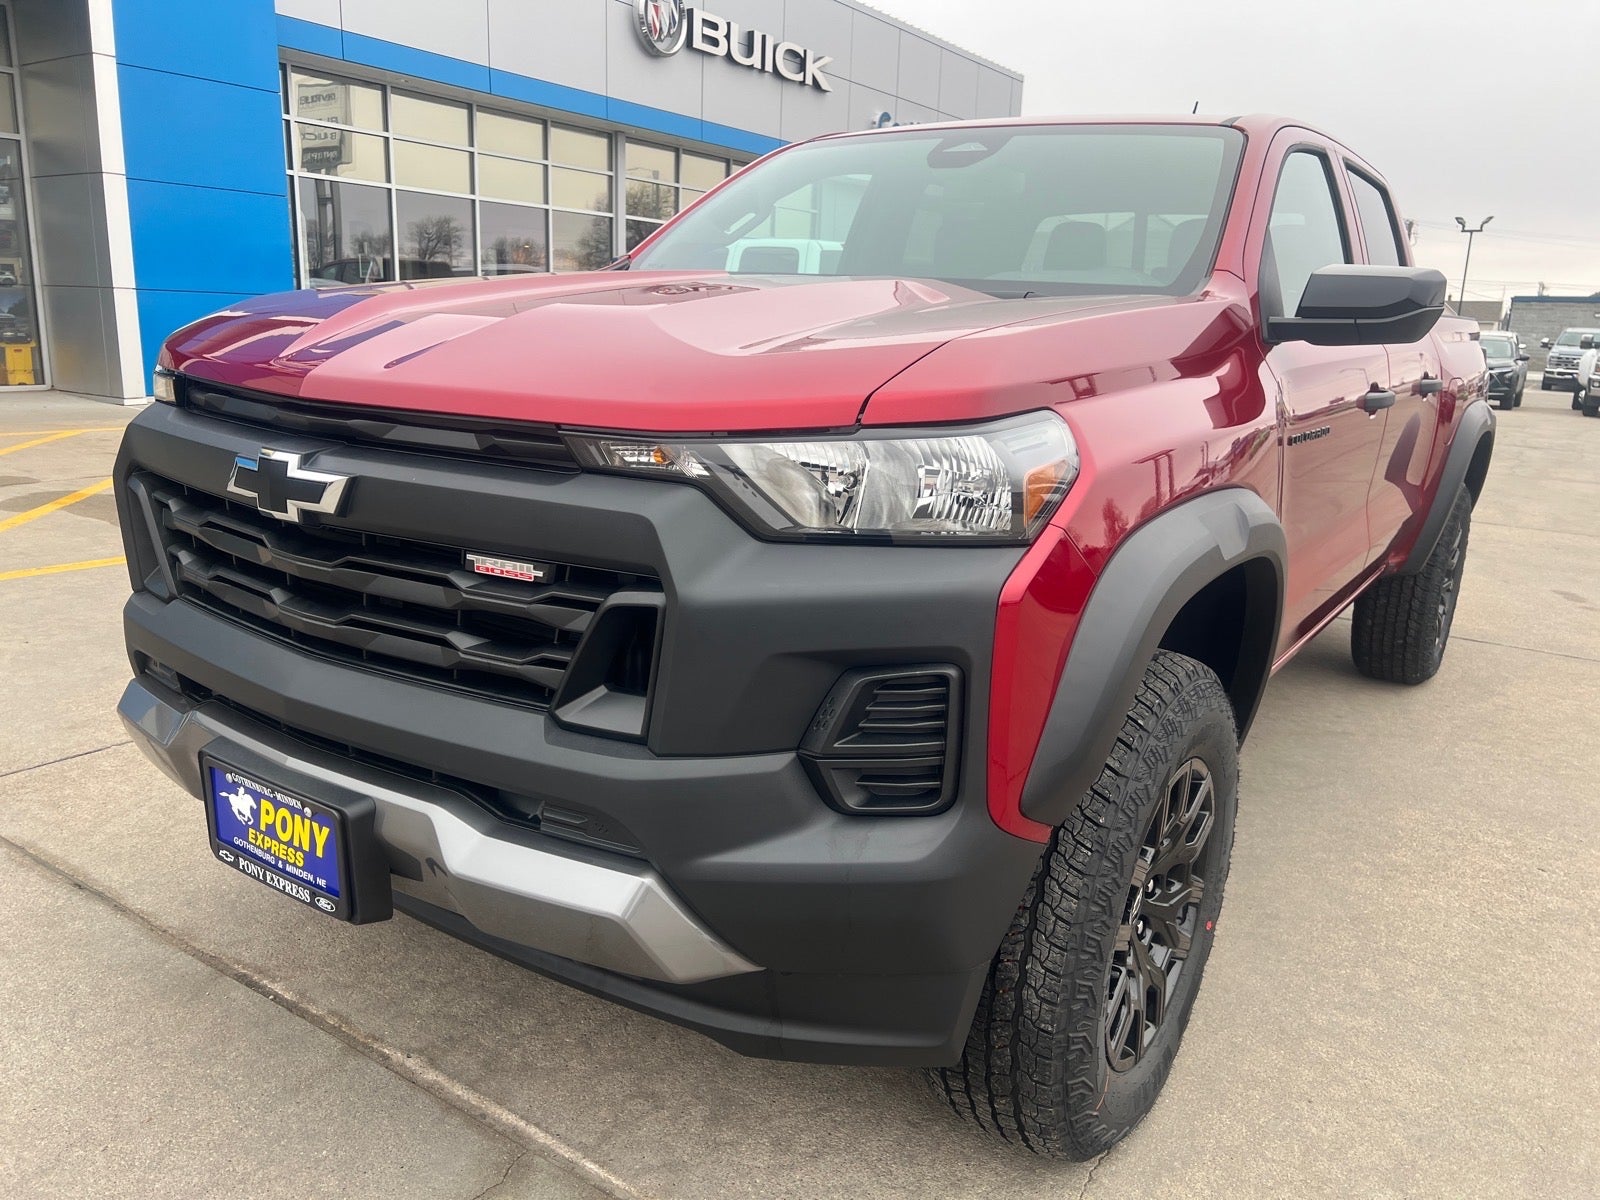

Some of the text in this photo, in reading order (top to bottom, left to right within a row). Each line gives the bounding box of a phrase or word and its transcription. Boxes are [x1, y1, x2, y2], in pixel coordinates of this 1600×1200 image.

[688, 8, 834, 92] BUICK
[467, 553, 543, 577] TRAIL
[475, 564, 534, 582] BOSS
[248, 828, 304, 867] EXPRESS
[260, 798, 330, 859] PONY
[233, 836, 327, 889] GOTHENBURG & MINDEN, NE
[239, 857, 310, 903] PONY EXPRESS
